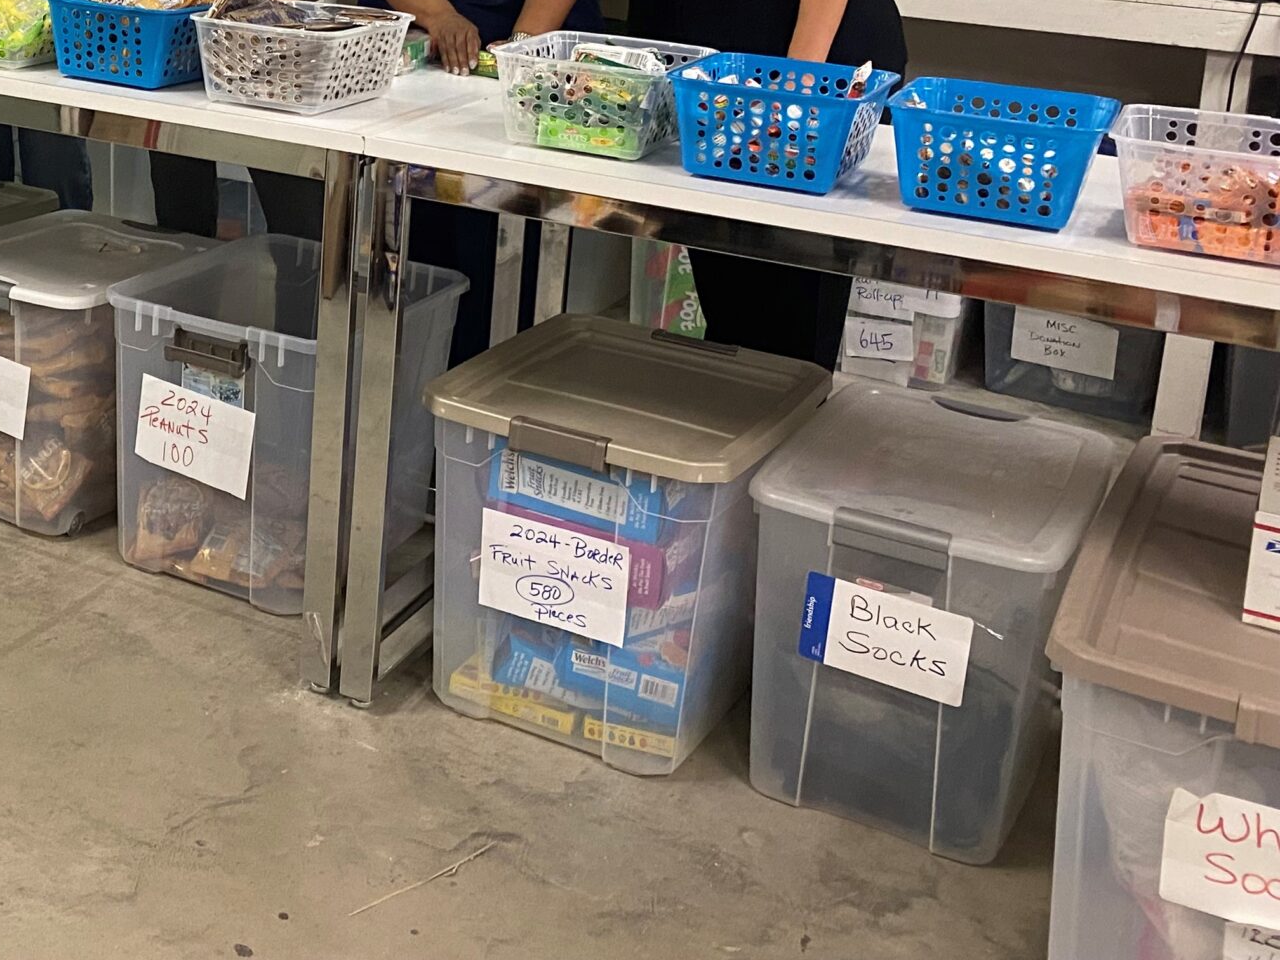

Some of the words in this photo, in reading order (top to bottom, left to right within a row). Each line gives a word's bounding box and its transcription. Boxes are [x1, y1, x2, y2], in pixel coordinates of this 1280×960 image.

[1046, 319, 1077, 334] MISC
[859, 330, 894, 351] 645
[161, 390, 213, 425] 2024
[162, 441, 194, 467] 100
[528, 582, 562, 601] 580
[803, 596, 818, 629] friendship
[574, 652, 606, 668] Welch's
